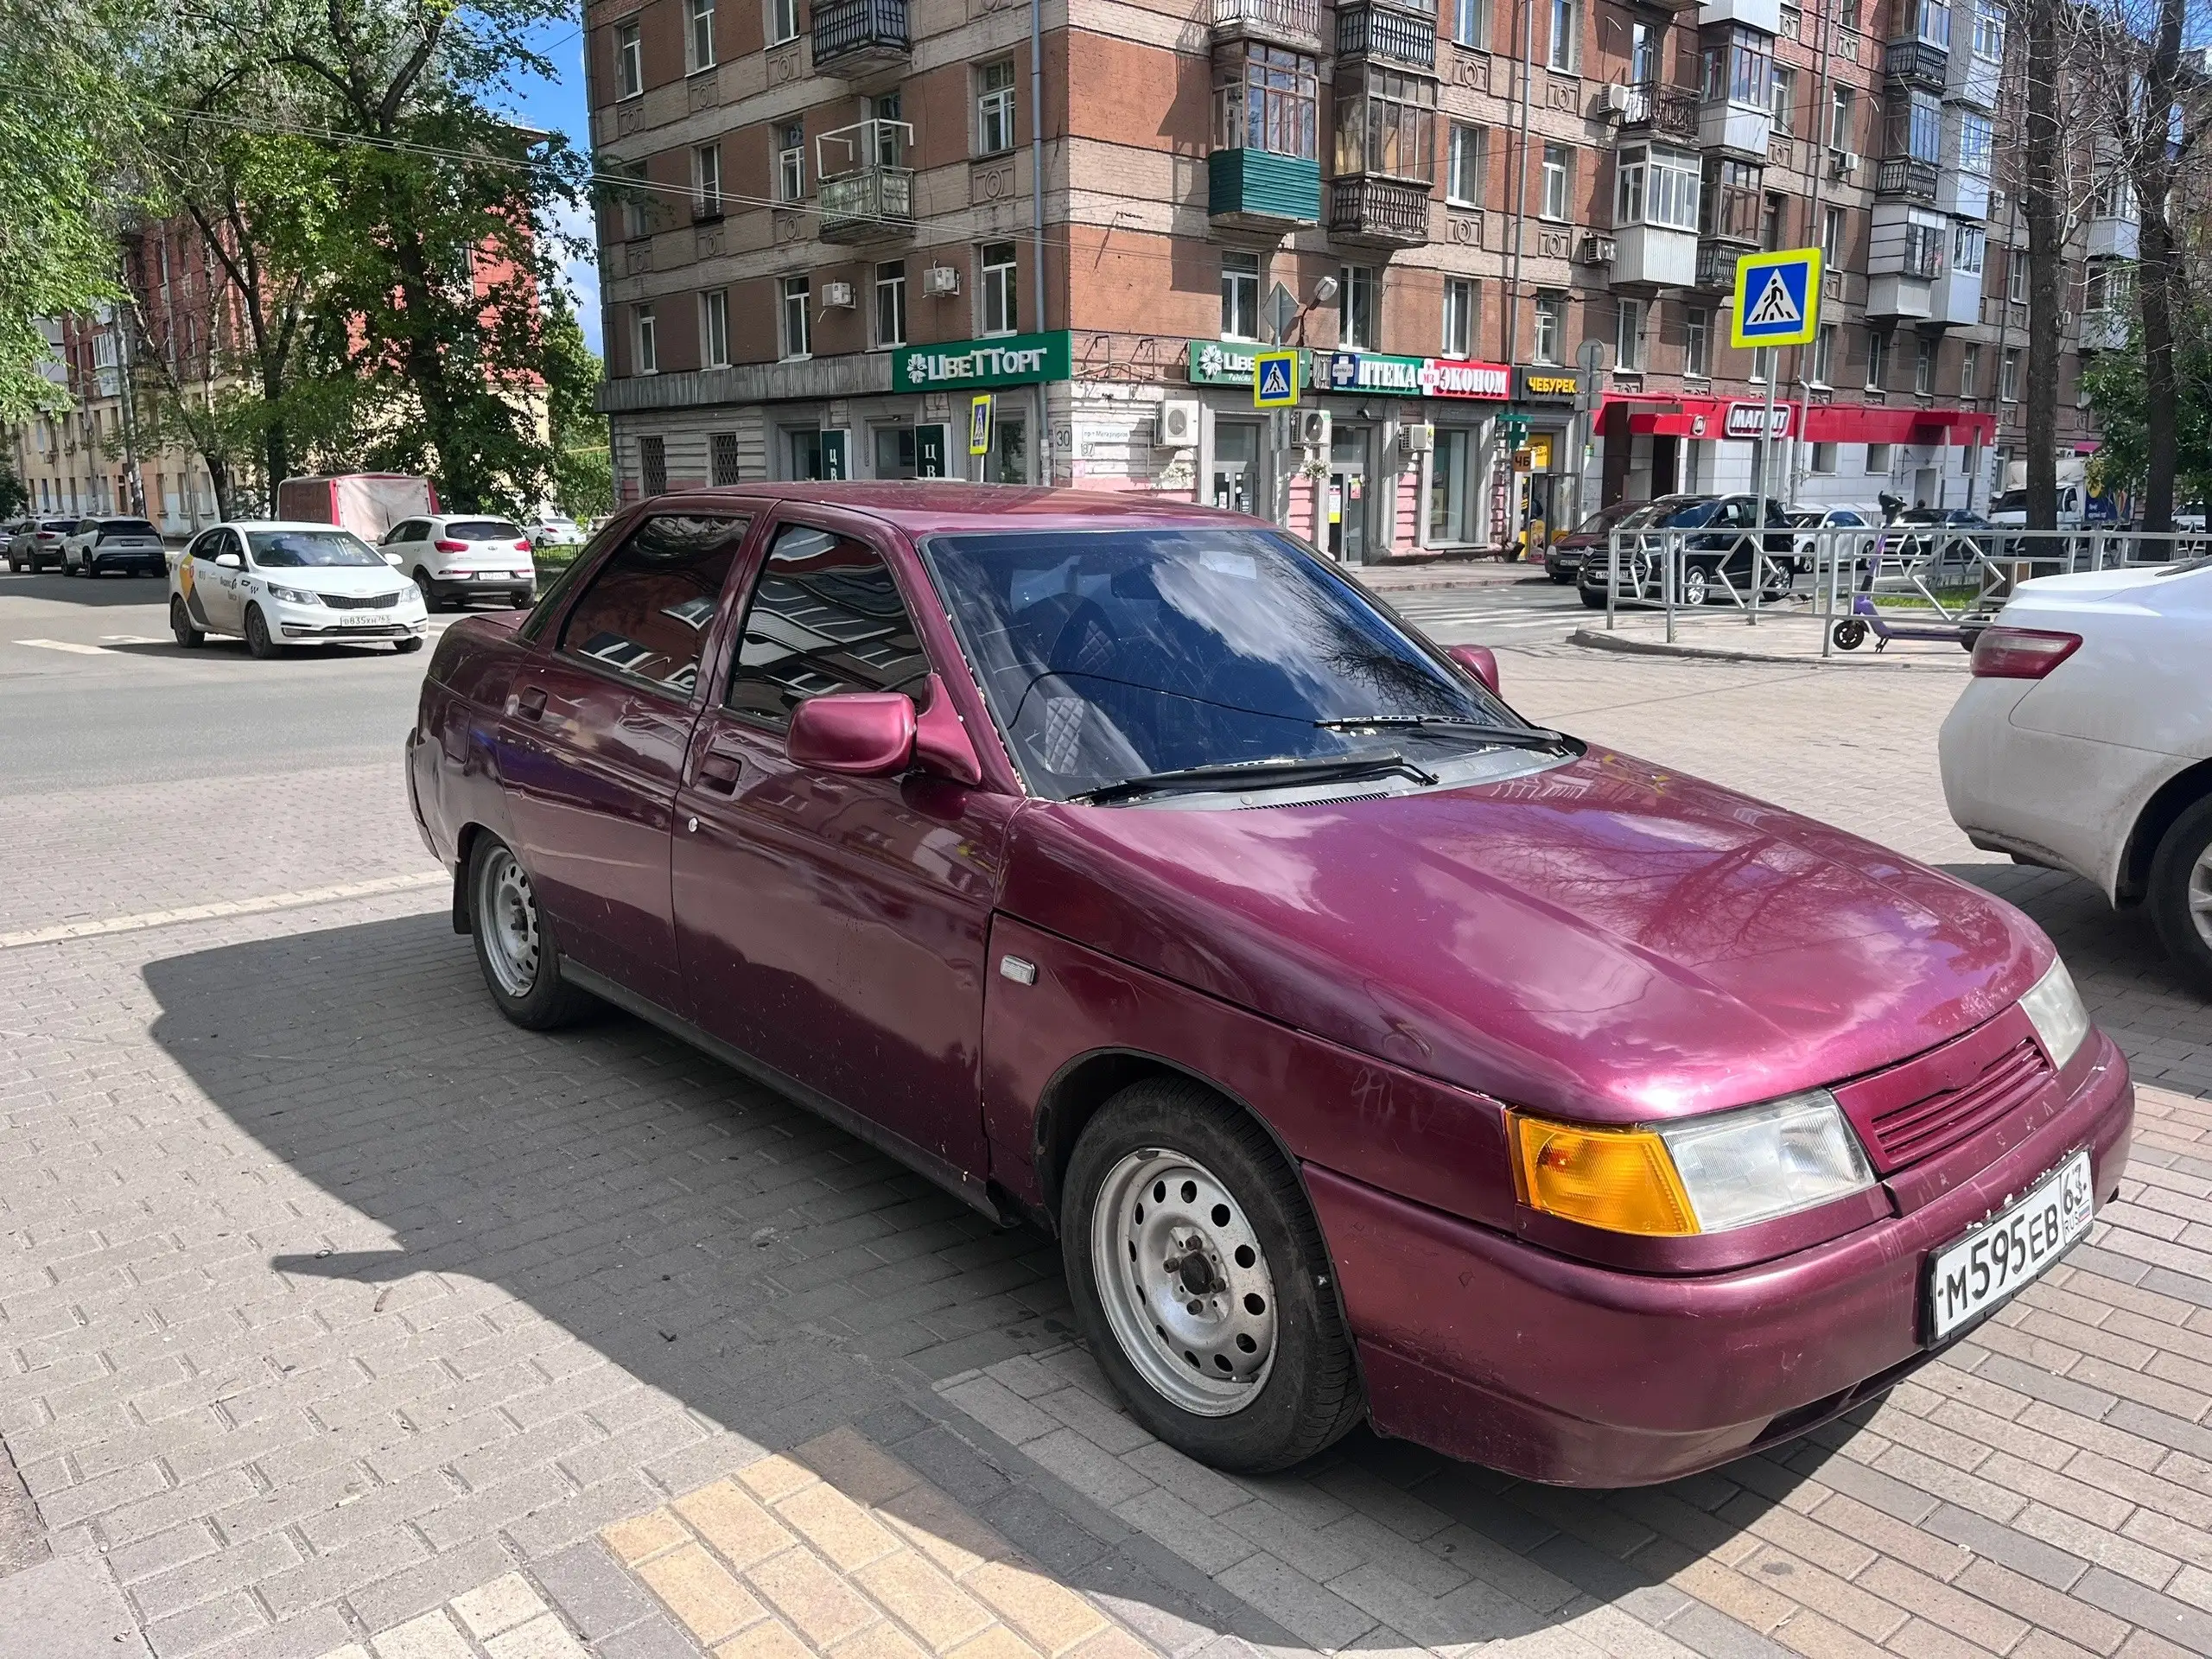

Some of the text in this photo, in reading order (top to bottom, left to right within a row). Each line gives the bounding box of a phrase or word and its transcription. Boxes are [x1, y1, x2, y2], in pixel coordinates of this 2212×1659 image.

[1358, 360, 1417, 388] ПТЕКА
[1439, 366, 1507, 394] ЭКОНОМ
[1056, 430, 1071, 447] 30
[1515, 455, 1530, 467] ЧБ
[2063, 1213, 2080, 1234] RUS
[1947, 1204, 2058, 1319] М595ЕВ
[2063, 1164, 2083, 1216] 63
